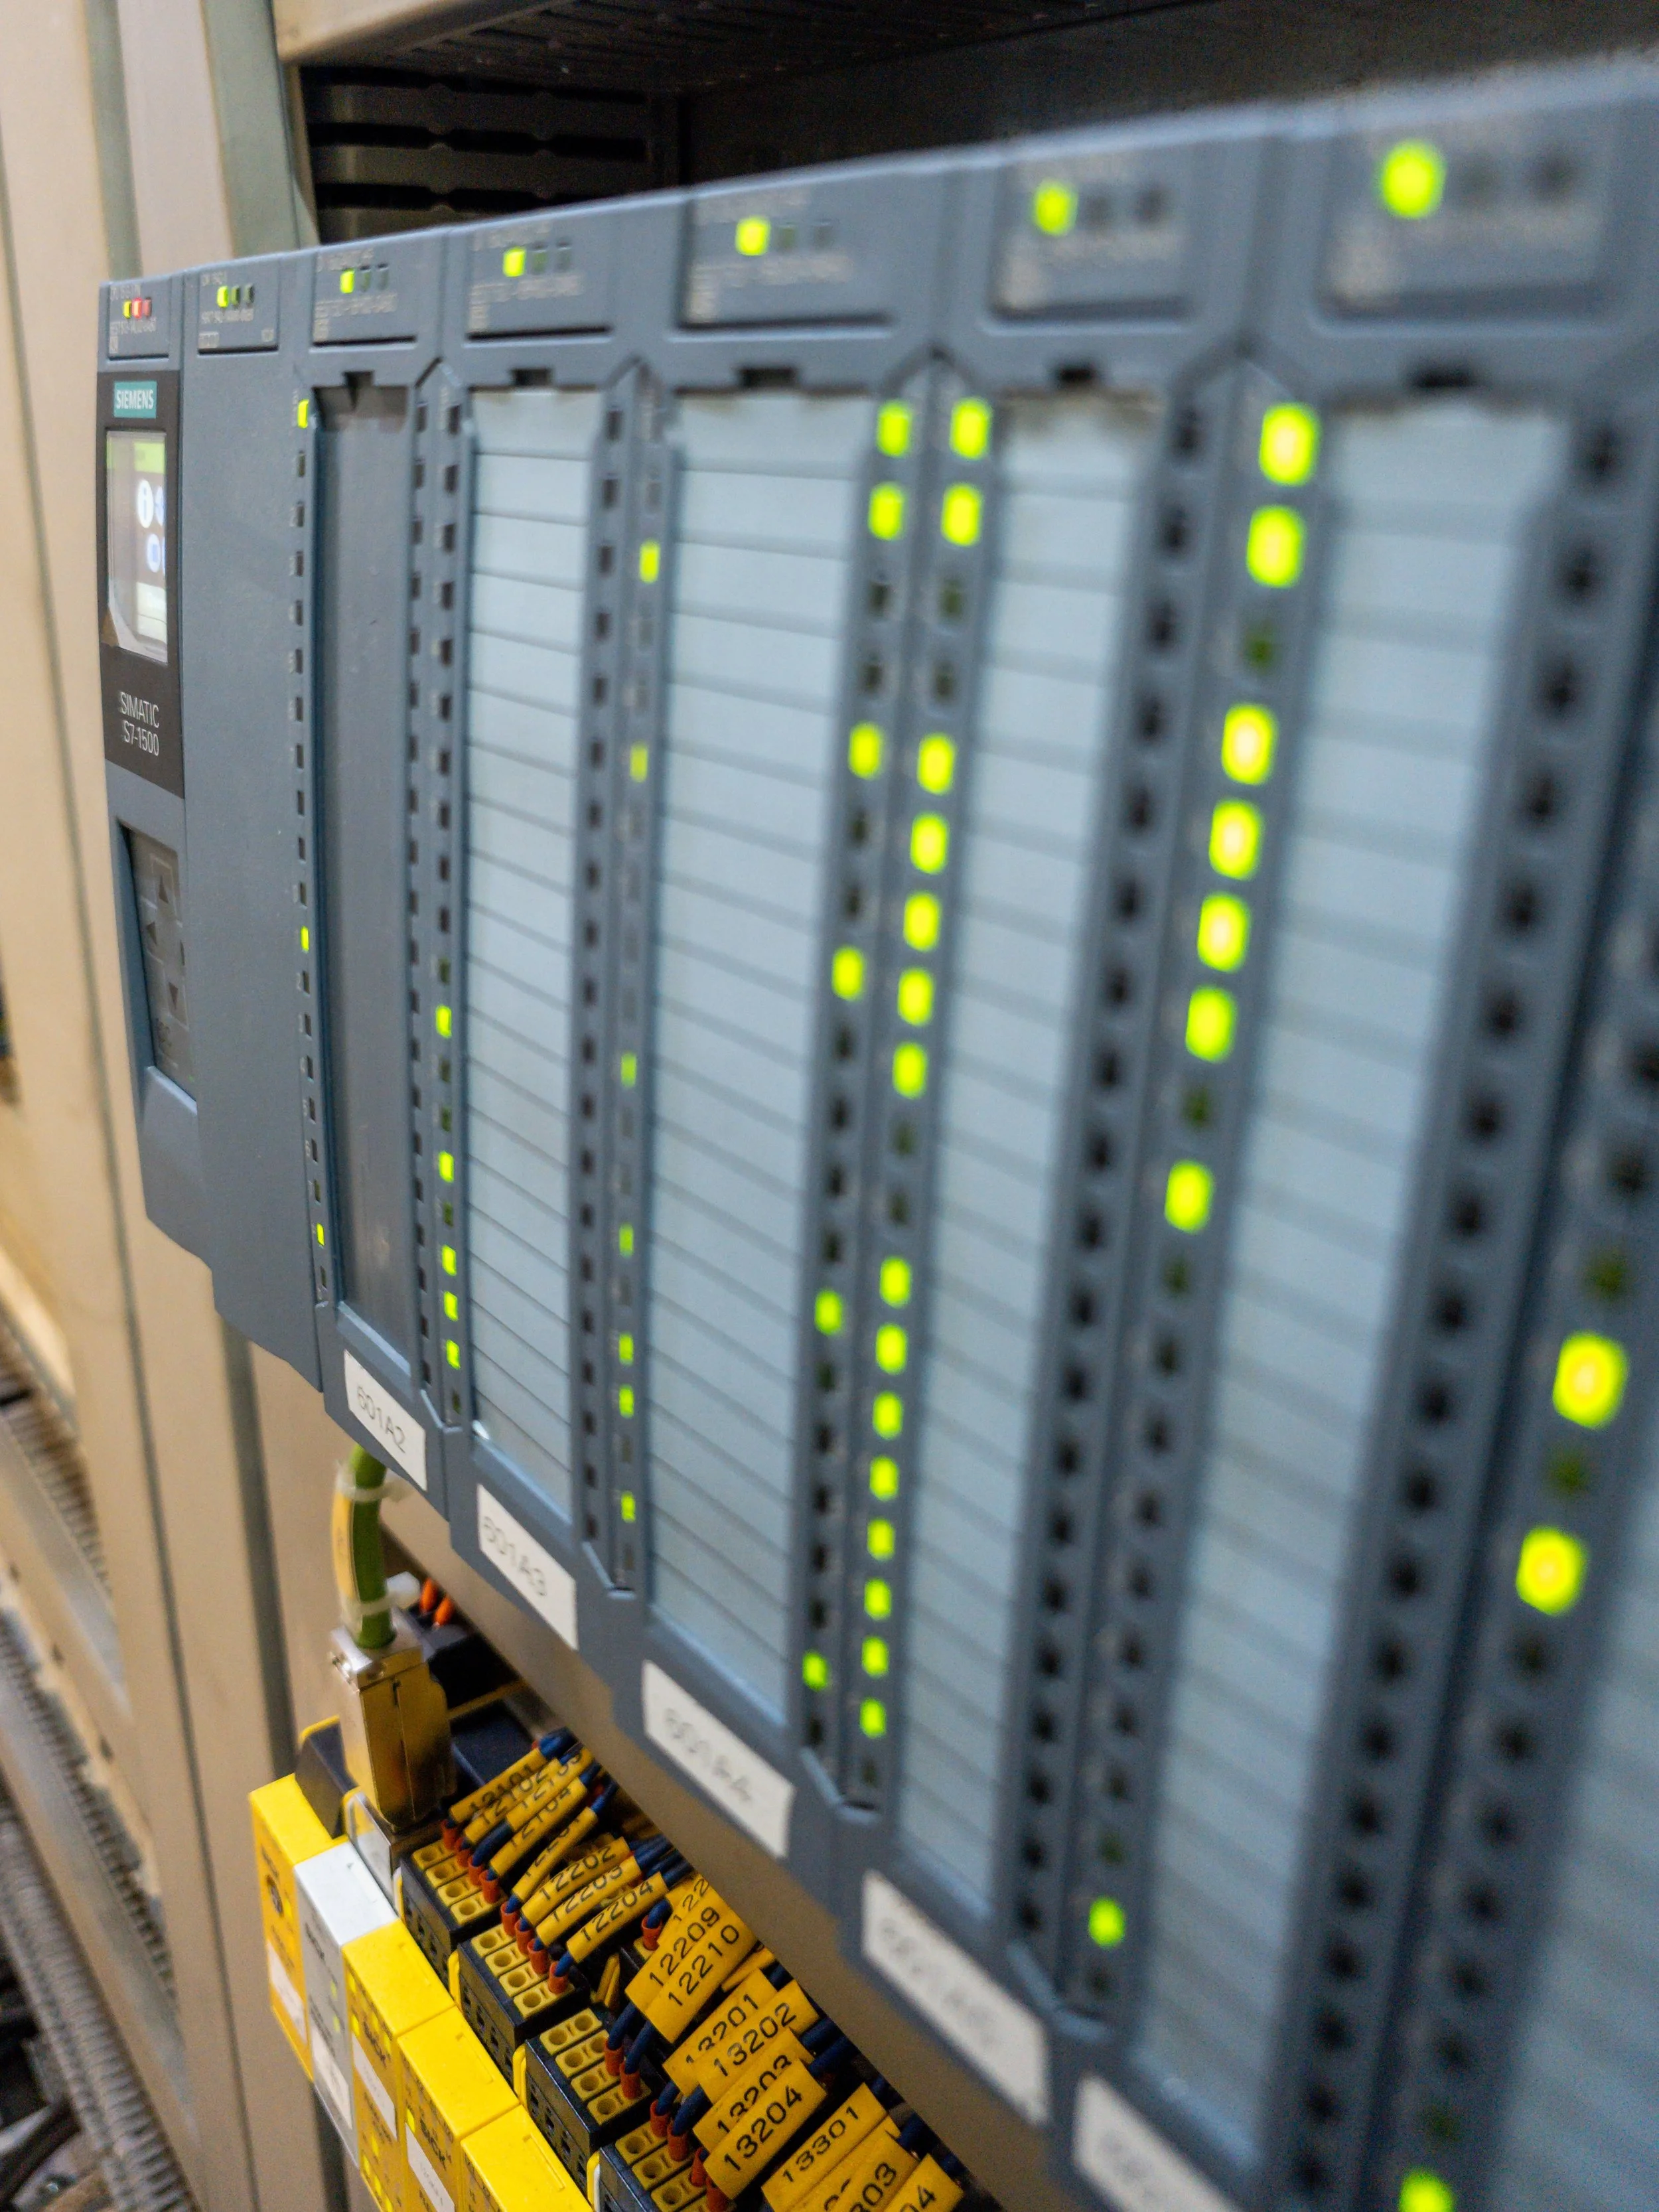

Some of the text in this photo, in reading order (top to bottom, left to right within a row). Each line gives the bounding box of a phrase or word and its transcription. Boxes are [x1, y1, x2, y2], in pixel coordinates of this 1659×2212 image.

[116, 389, 154, 409] SIEMENS
[119, 692, 160, 729] SIMATIC
[122, 719, 159, 756] S7-1500
[356, 1384, 406, 1454] 601A2
[539, 1844, 616, 1902] 12202
[551, 1864, 622, 1923] 12203
[579, 1880, 654, 1943] 12204
[649, 1906, 721, 1987] 12209
[668, 1924, 740, 2007] 12210
[713, 2002, 797, 2077] 13202
[723, 2085, 803, 2172] 13204
[782, 2105, 859, 2183] 13301
